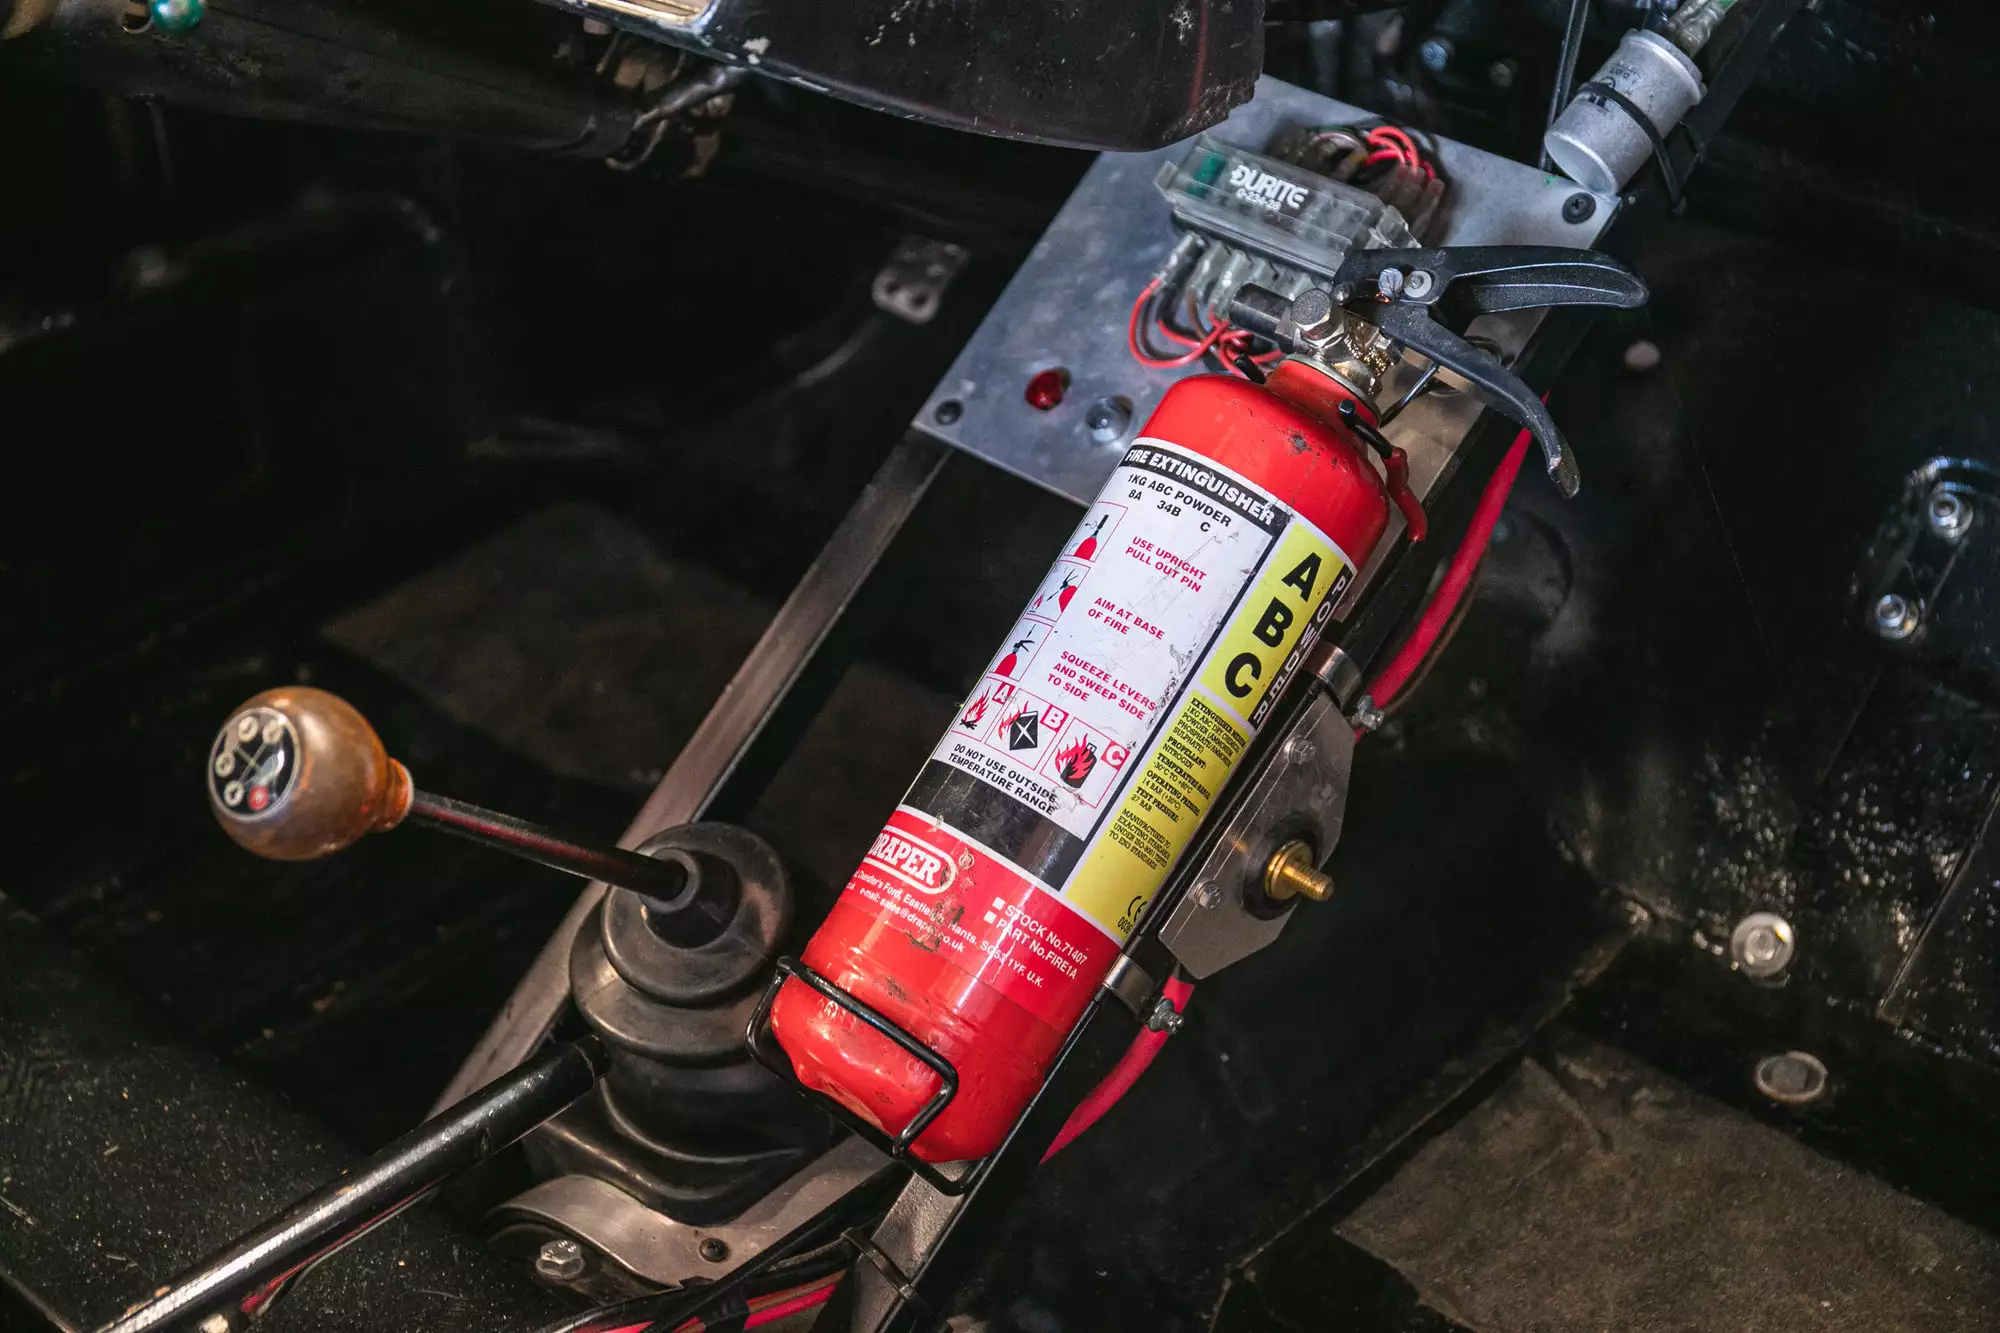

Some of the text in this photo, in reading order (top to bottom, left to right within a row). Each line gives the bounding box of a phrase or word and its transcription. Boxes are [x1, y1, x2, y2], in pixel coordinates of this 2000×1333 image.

[1229, 164, 1309, 210] DURITE
[1124, 449, 1275, 525] FIRE EXTINGUISHER
[1128, 473, 1232, 527] 1KG ABC POWDER
[1128, 489, 1211, 532] 8A 34B C
[1125, 546, 1202, 593] PULL OUT PIN
[1132, 536, 1207, 580] USE UPRIGHT
[1087, 608, 1130, 635] OF FIRE
[1094, 597, 1165, 640] AIM AT BASE
[1047, 673, 1090, 702] TO SIDE
[1053, 663, 1146, 721] AND SWEEP SIDE
[1060, 650, 1157, 711] SQUEEZE LEVERS
[1044, 709, 1064, 729] B
[1182, 712, 1209, 734] POWDER
[1187, 705, 1200, 718] 1KG
[1199, 715, 1212, 728] ABC
[1212, 725, 1224, 736] DRY
[1105, 744, 1126, 767] C
[1162, 743, 1194, 769] NITROGEN
[1173, 726, 1205, 754] SULPHATE)
[948, 752, 1056, 816] TEMPERATURE RANGE
[953, 743, 1058, 803] DO NOT USE OUTSIDE
[1142, 777, 1150, 786] 14
[1149, 783, 1163, 796] BAR
[1146, 769, 1183, 800] OPERATING
[1156, 752, 1199, 789] TEMPERATURE
[1169, 772, 1178, 782] TO
[1131, 794, 1153, 812] 27 BAR
[1136, 786, 1154, 802] TEST
[1109, 830, 1119, 841] TO
[1113, 823, 1135, 841] UNDER
[1117, 815, 1149, 841] EXACTING
[1121, 808, 1171, 849] MANUFACTURED TO
[868, 832, 941, 886] DRAPER
[883, 882, 904, 900] Ford,
[1026, 970, 1044, 988] U.K.
[996, 918, 1079, 980] PART No.FIRE1A
[1004, 904, 1088, 966] STOCK No.71407
